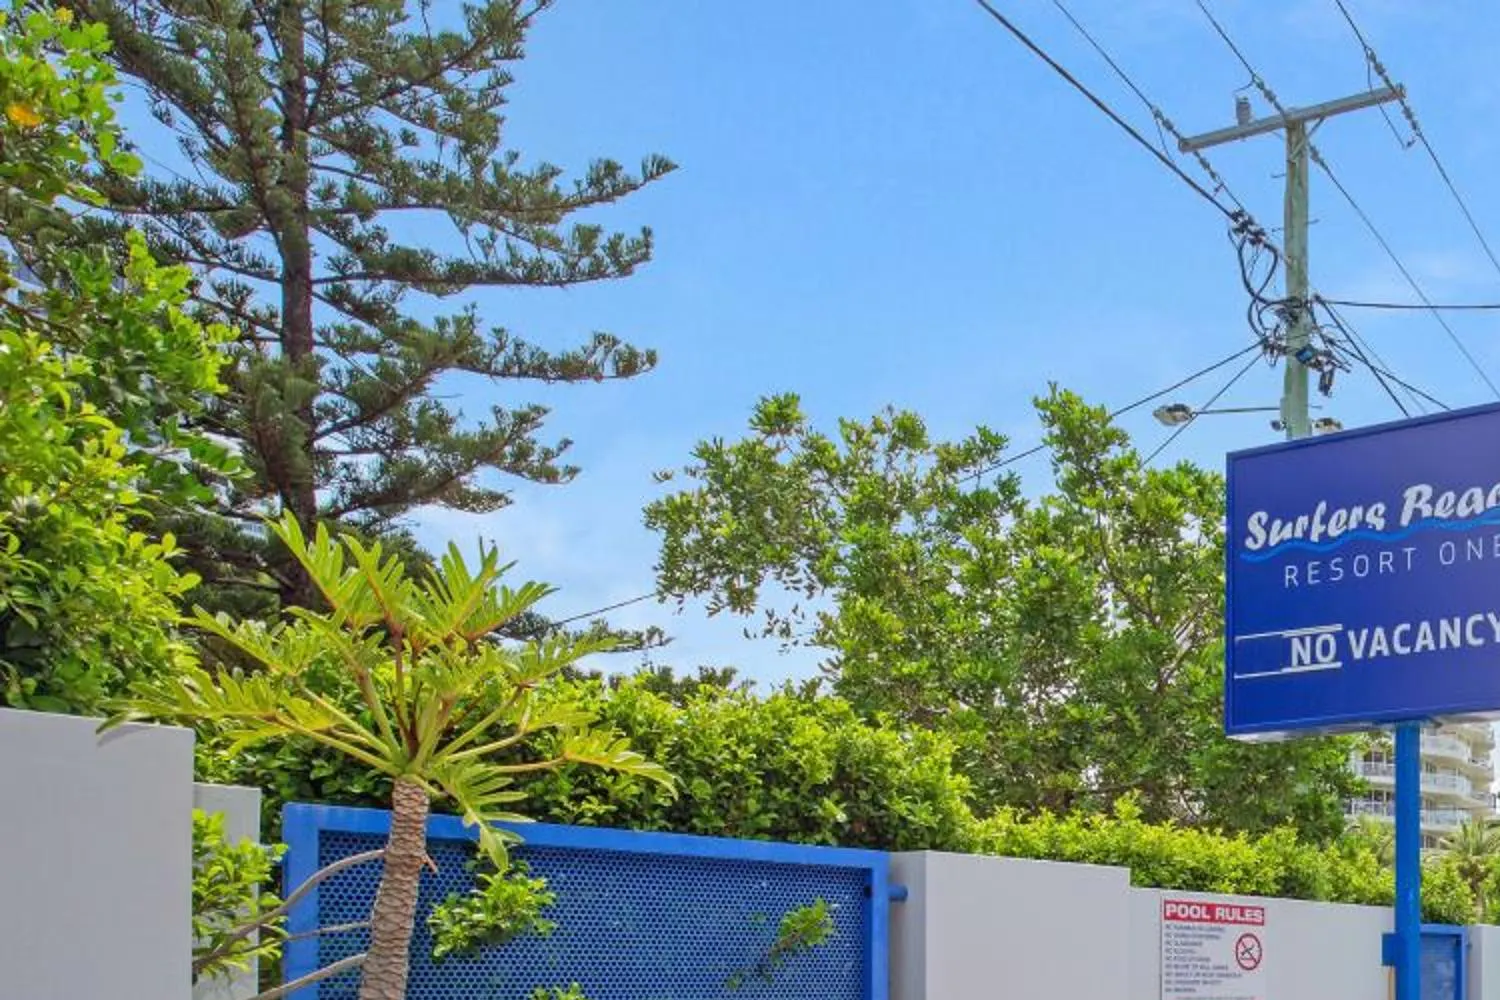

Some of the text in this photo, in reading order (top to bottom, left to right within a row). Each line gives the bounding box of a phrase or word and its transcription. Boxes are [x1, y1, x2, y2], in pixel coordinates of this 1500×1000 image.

[1244, 500, 1386, 552] Surfers
[1284, 547, 1417, 589] RESORT
[1290, 633, 1338, 668] NO
[1165, 903, 1263, 923] POOL RULES
